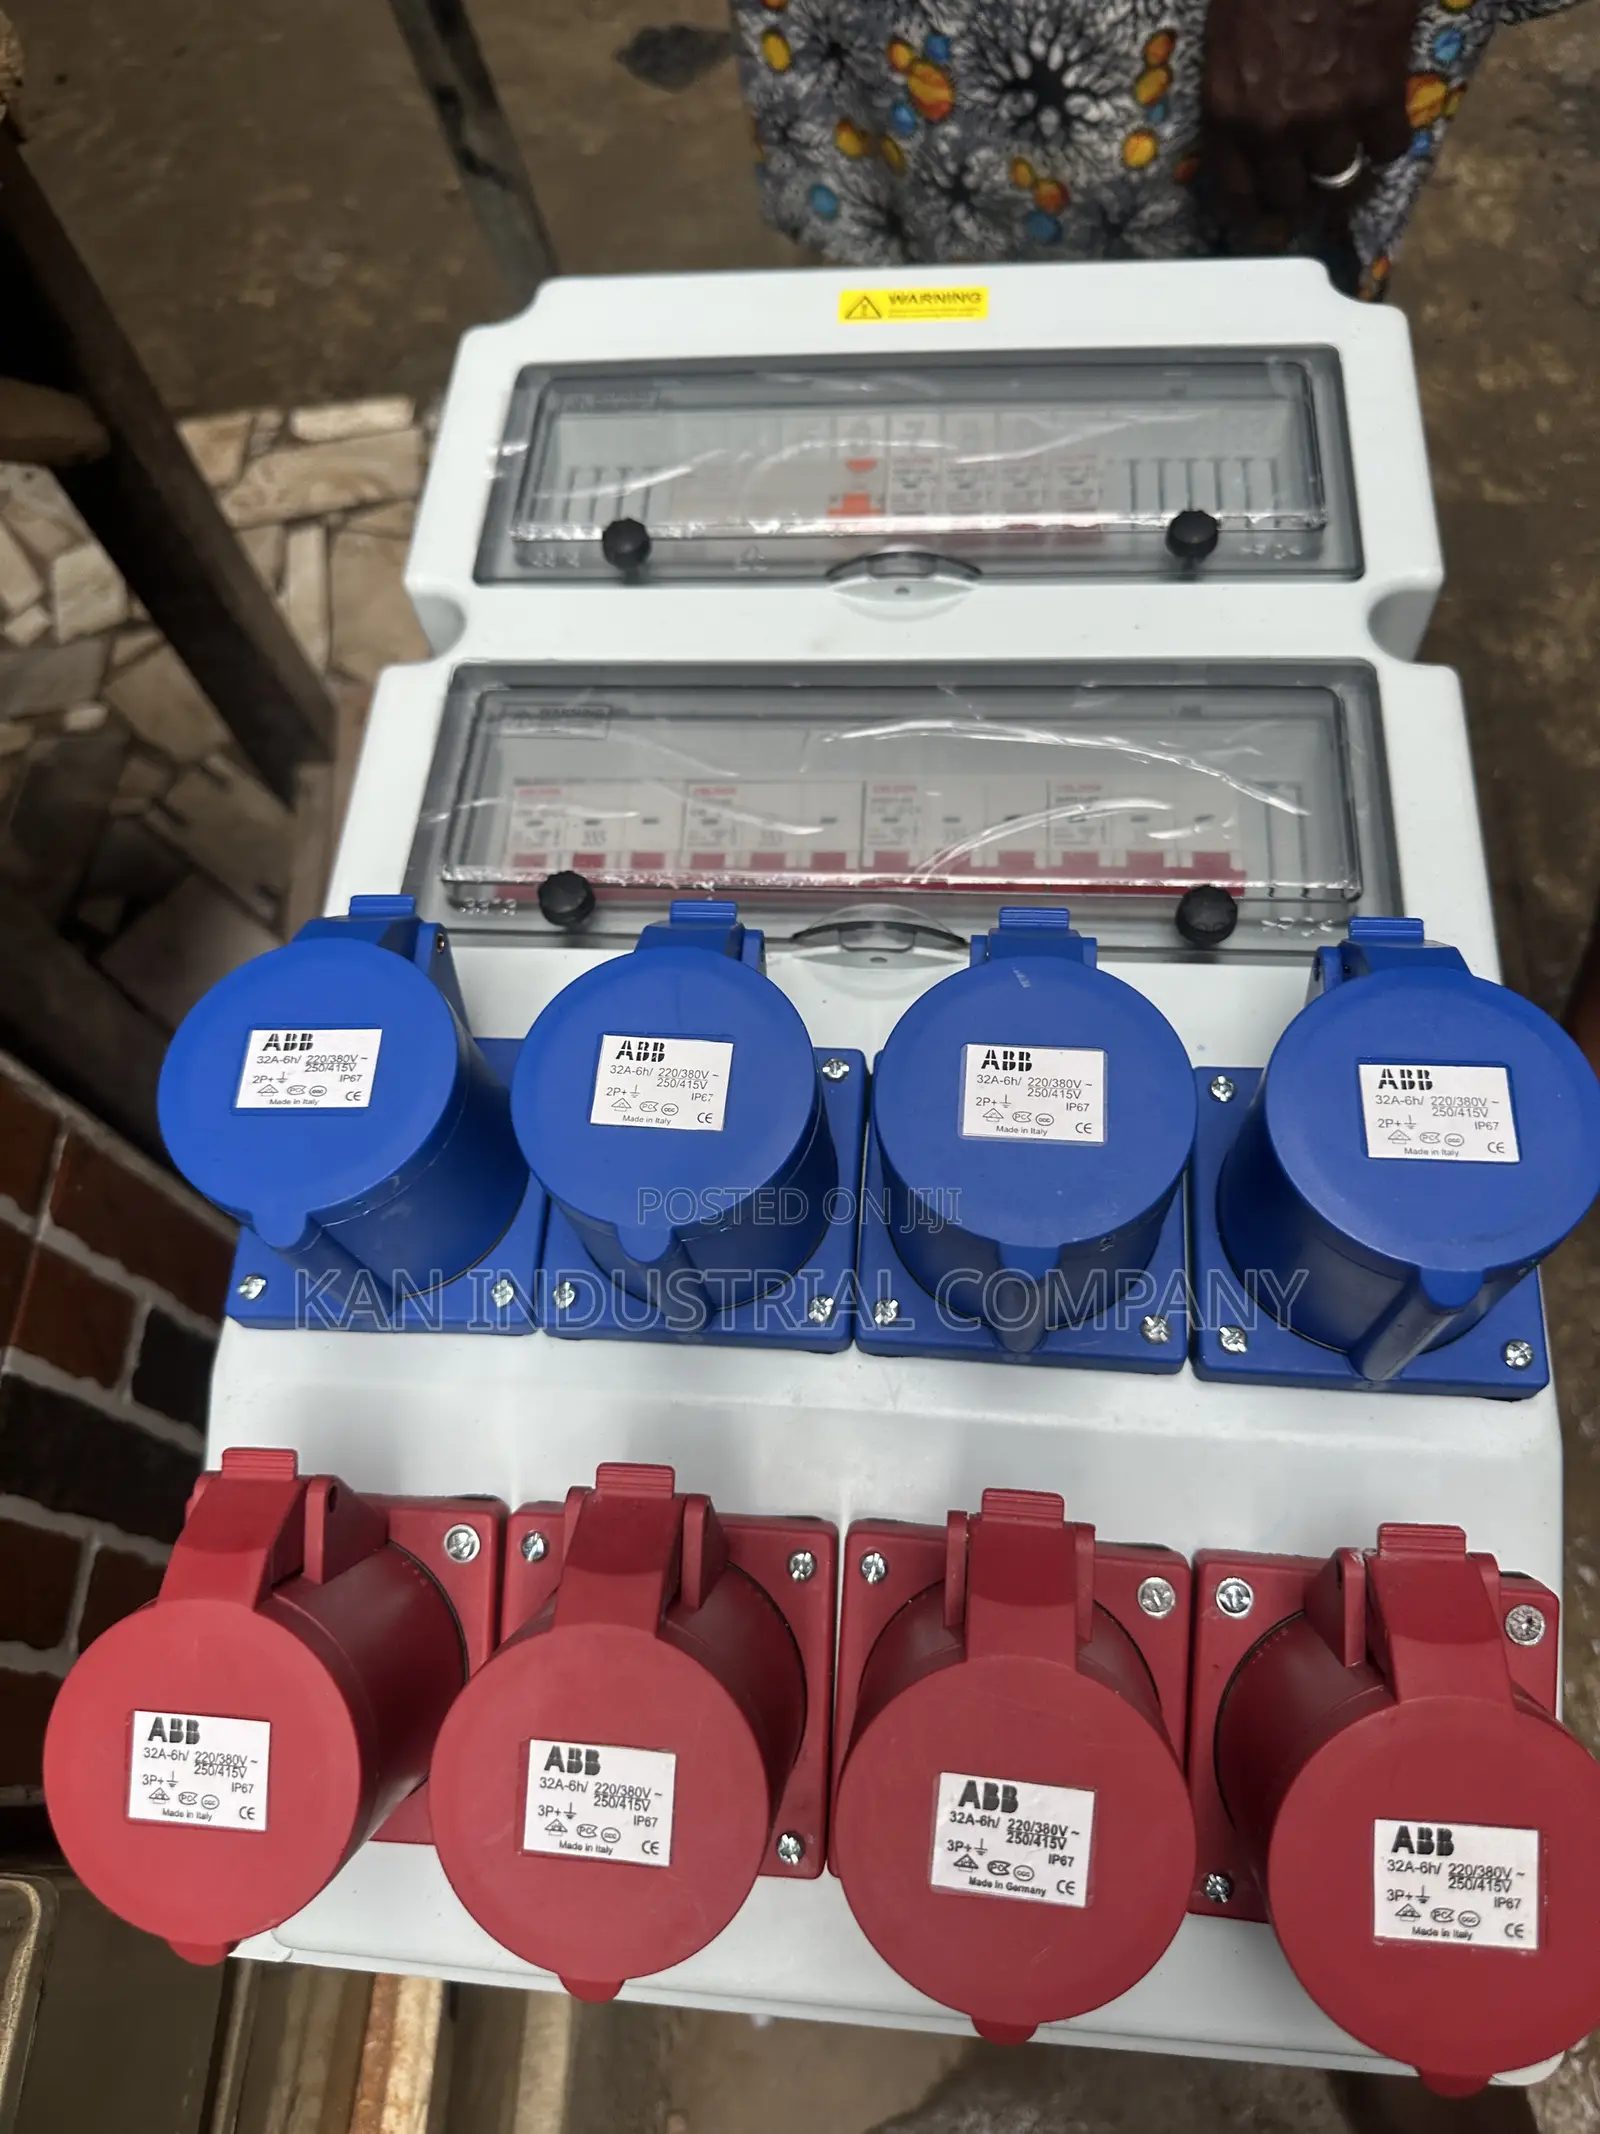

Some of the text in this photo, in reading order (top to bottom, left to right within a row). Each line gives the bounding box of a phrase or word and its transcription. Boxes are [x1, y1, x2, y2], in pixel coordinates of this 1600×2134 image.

[888, 292, 981, 304] WARNING
[263, 1033, 313, 1051] ABB
[616, 1040, 665, 1062] ABB
[981, 1050, 1032, 1071] ABB
[305, 1063, 356, 1072] 250/415V
[657, 1079, 708, 1089] 250/415V
[1378, 1069, 1433, 1090] ABB
[1027, 1088, 1081, 1099] 250/415V
[1066, 1103, 1089, 1112] IP67
[1432, 1107, 1488, 1117] 250/415V
[655, 1117, 671, 1125] Italy
[1475, 1121, 1499, 1130] IP67
[996, 1125, 1019, 1133] Made
[1031, 1128, 1048, 1136] Italy
[1442, 1149, 1459, 1157] Italy
[148, 1717, 200, 1744] ABB
[544, 1745, 601, 1775] ABB
[194, 1764, 247, 1778] 250/415V
[232, 1782, 254, 1793] IP67
[958, 1780, 1019, 1813] ABB
[594, 1795, 651, 1812] 250/415V
[163, 1808, 212, 1821] Made in Italy
[633, 1815, 658, 1828] IP67
[1006, 1832, 1067, 1850] 250/415V
[1391, 1825, 1454, 1856] ABB
[559, 1840, 613, 1855] Made in Italy
[1048, 1854, 1074, 1867] IP67
[969, 1876, 1046, 1897] Made in Germany
[1448, 1878, 1512, 1893] 250/415V
[1494, 1897, 1521, 1909] IP67
[1412, 1926, 1473, 1940] Made in Italy
